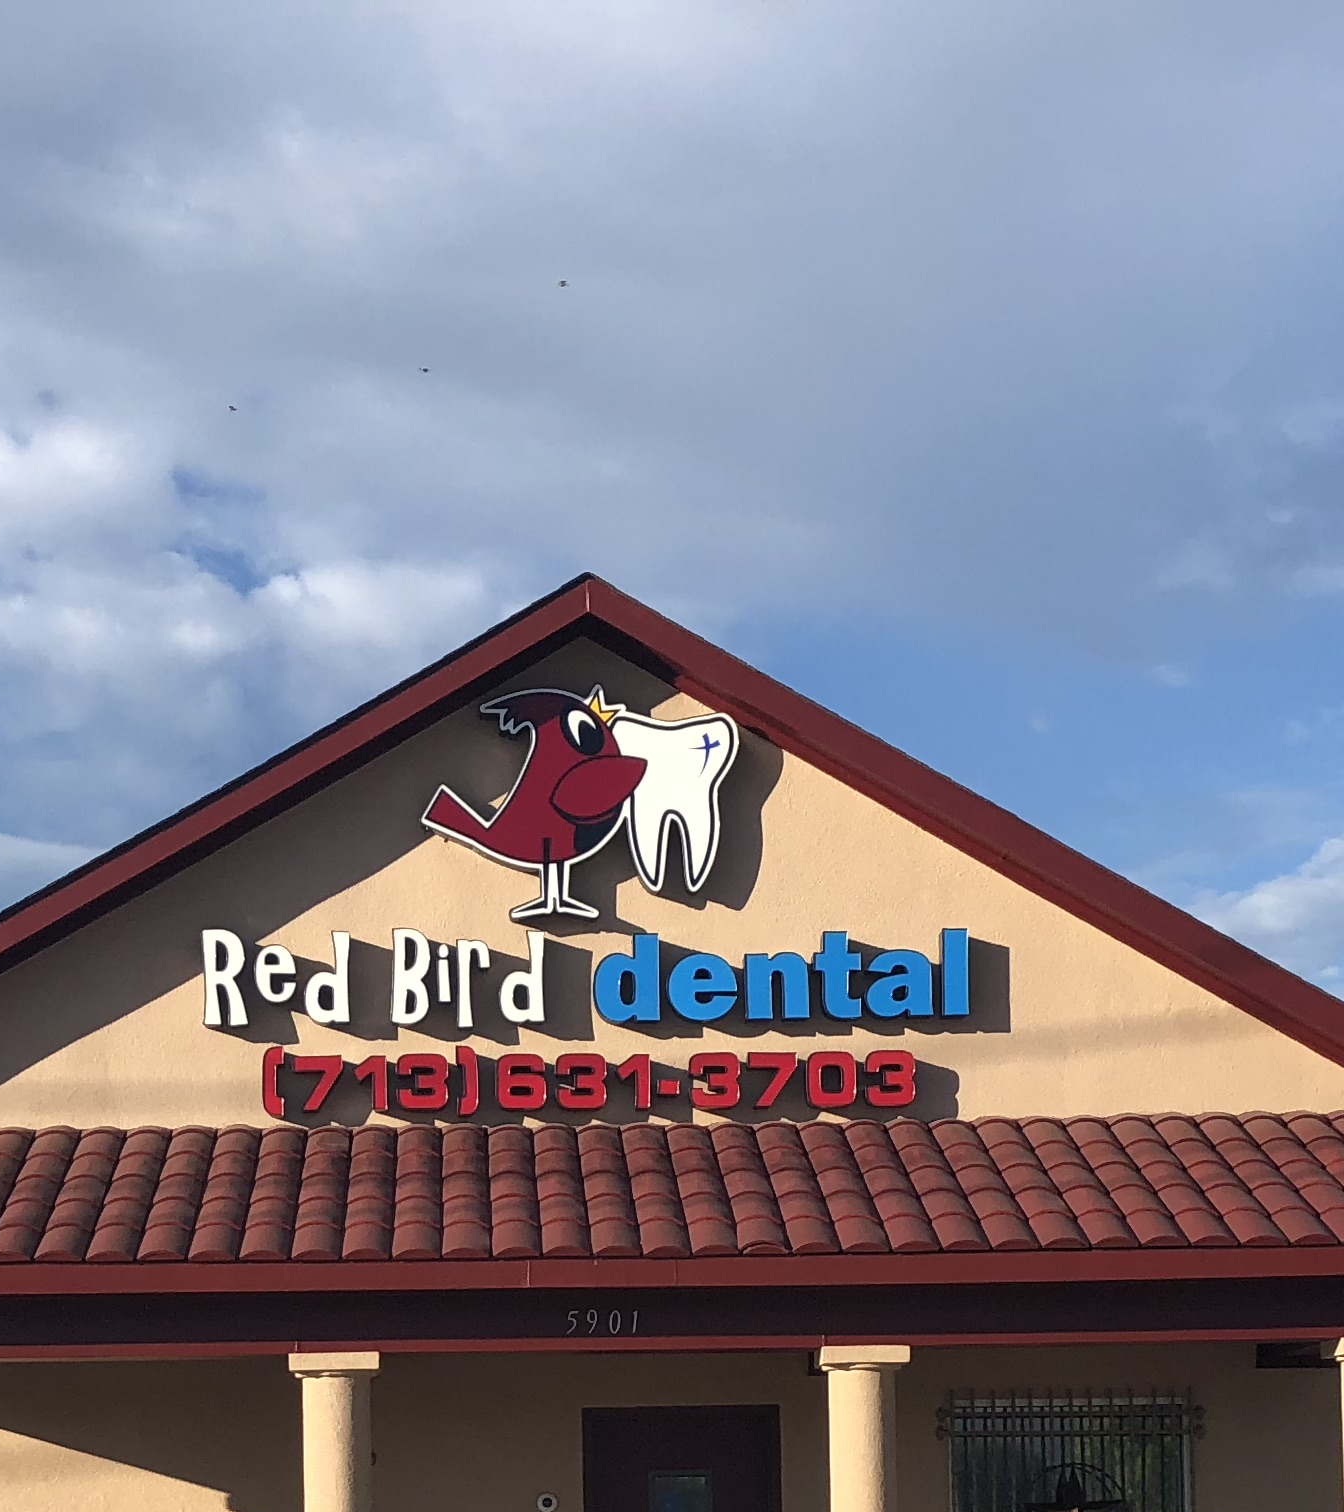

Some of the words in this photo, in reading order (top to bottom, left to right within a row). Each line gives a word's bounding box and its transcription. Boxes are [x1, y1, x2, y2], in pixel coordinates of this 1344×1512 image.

[202, 928, 350, 1027] Red
[390, 927, 545, 1028] Bird
[594, 928, 969, 1022] dental
[262, 1045, 916, 1116] (713)631-3703
[566, 1309, 638, 1334] 5901
